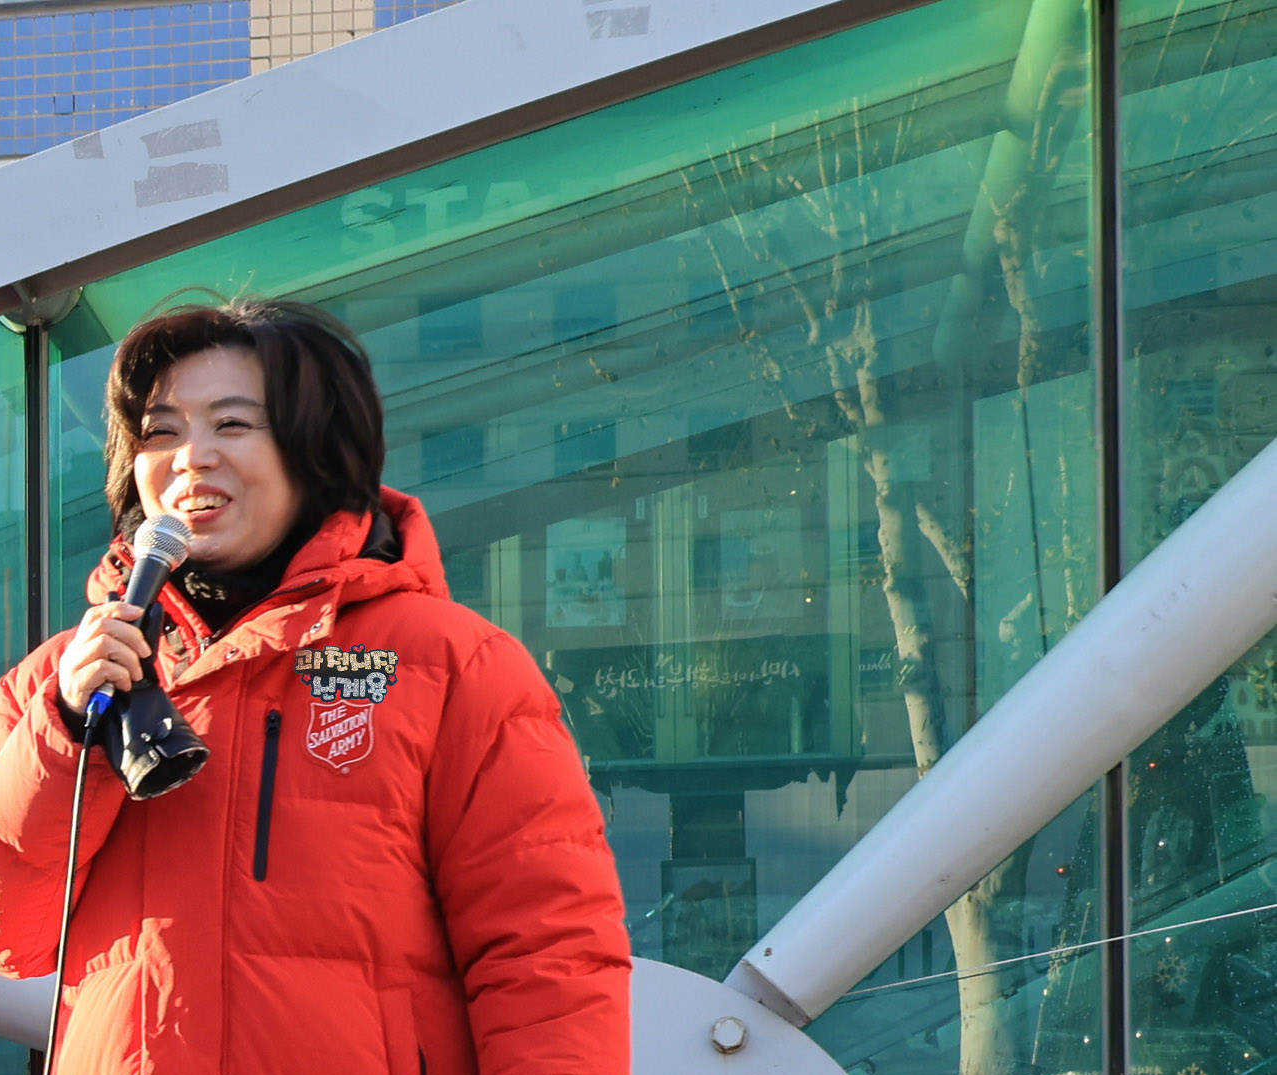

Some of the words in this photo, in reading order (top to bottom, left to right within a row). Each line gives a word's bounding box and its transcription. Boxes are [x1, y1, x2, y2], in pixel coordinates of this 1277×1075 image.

[309, 709, 368, 749] SALVATION
[320, 706, 347, 726] THE
[328, 729, 365, 759] ARMY
